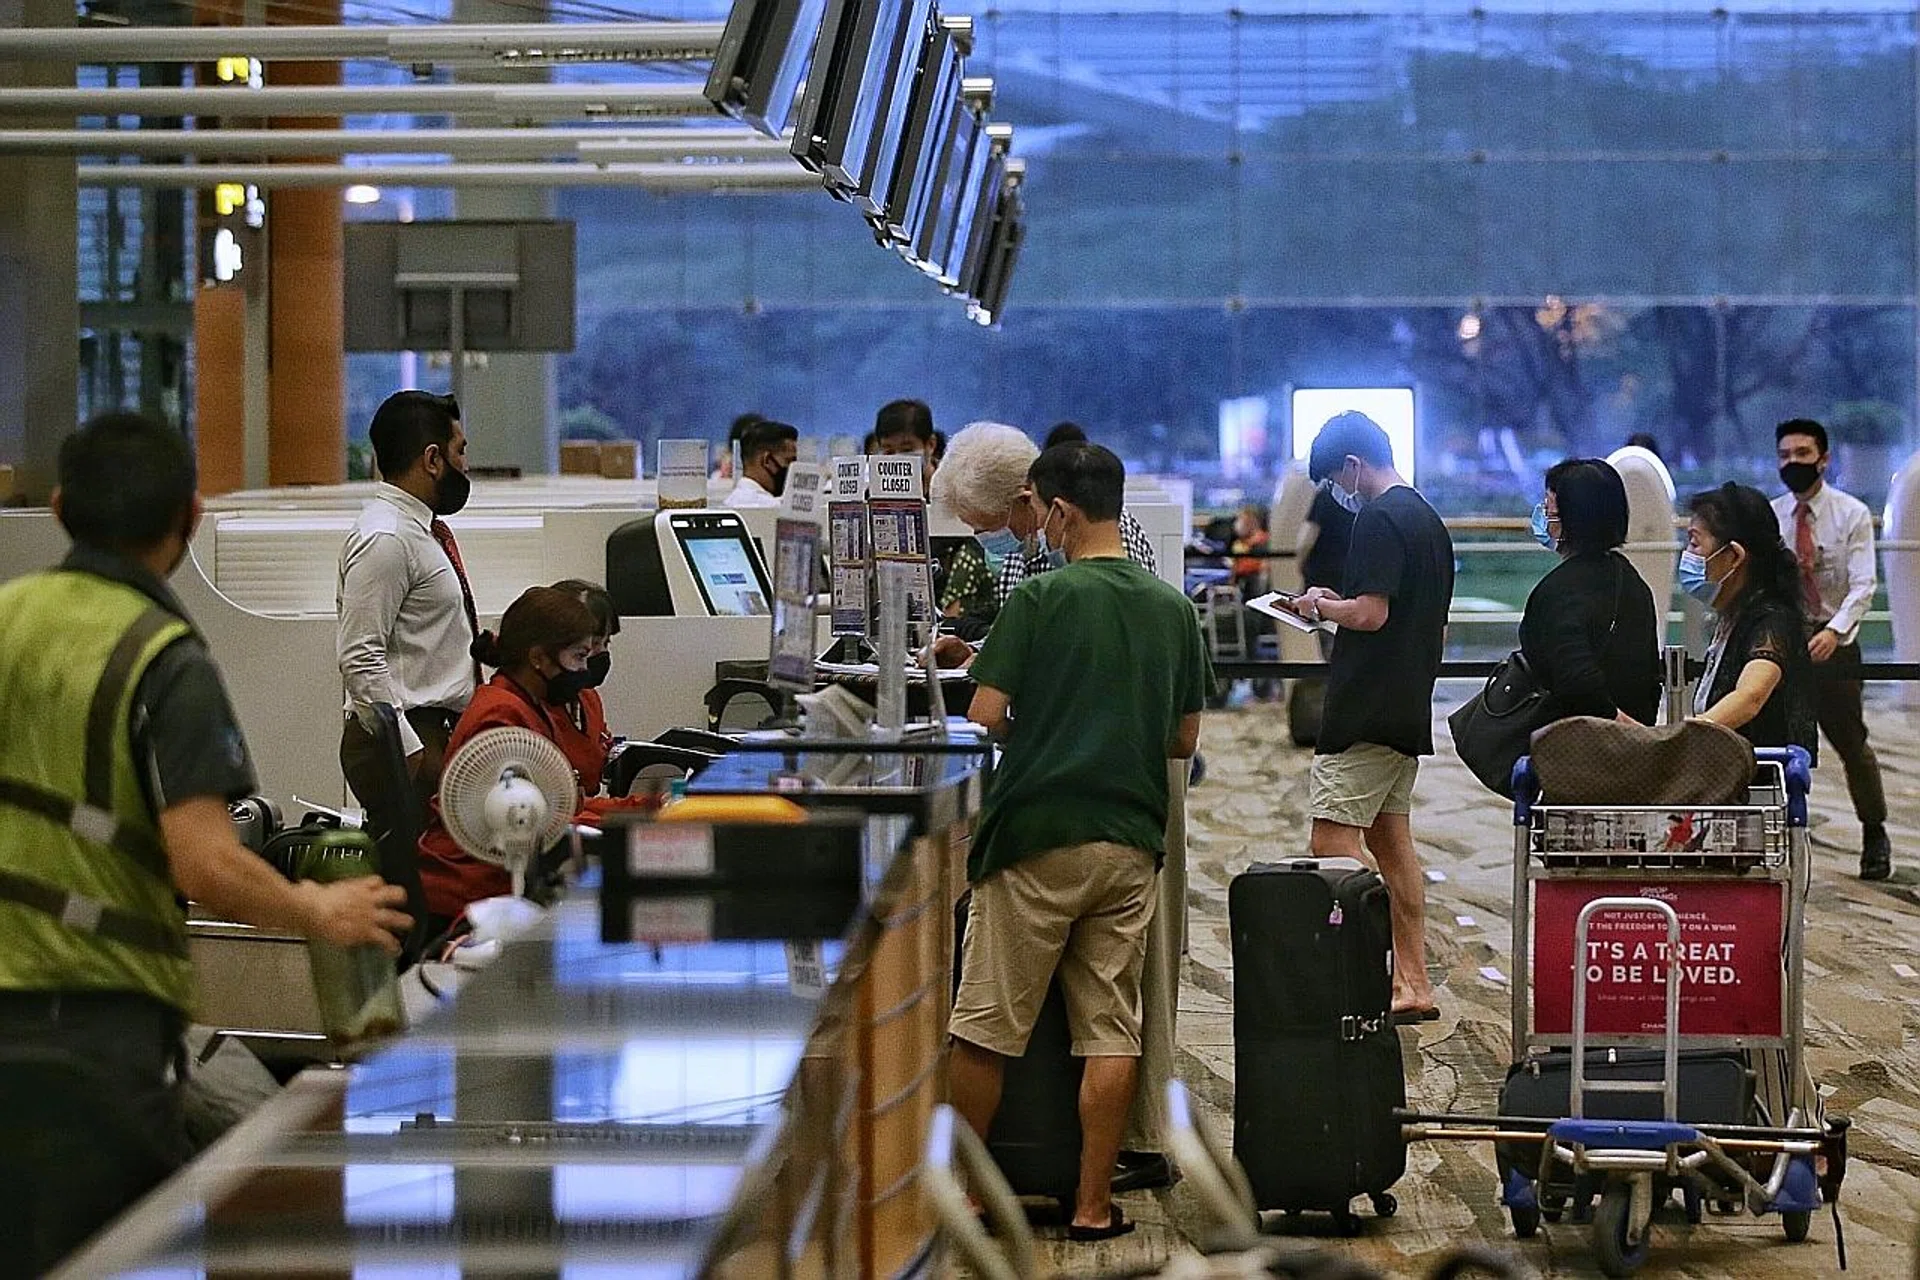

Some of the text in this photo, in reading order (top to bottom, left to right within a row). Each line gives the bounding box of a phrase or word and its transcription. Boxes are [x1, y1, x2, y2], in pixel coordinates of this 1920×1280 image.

[838, 463, 860, 477] COUNTER
[878, 462, 913, 476] COUNTER
[839, 480, 858, 494] CLOSED
[882, 479, 911, 492] CLOSED
[1604, 912, 1620, 920] NOT
[1624, 912, 1644, 920] JUST
[1597, 922, 1612, 931] THE
[1615, 922, 1655, 931] FREEDOM
[1689, 924, 1701, 932] ON
[1704, 924, 1710, 932] A
[1587, 942, 1625, 960] T'S
[1632, 942, 1648, 960] A
[1571, 965, 1603, 983] O
[1613, 966, 1643, 983] BE
